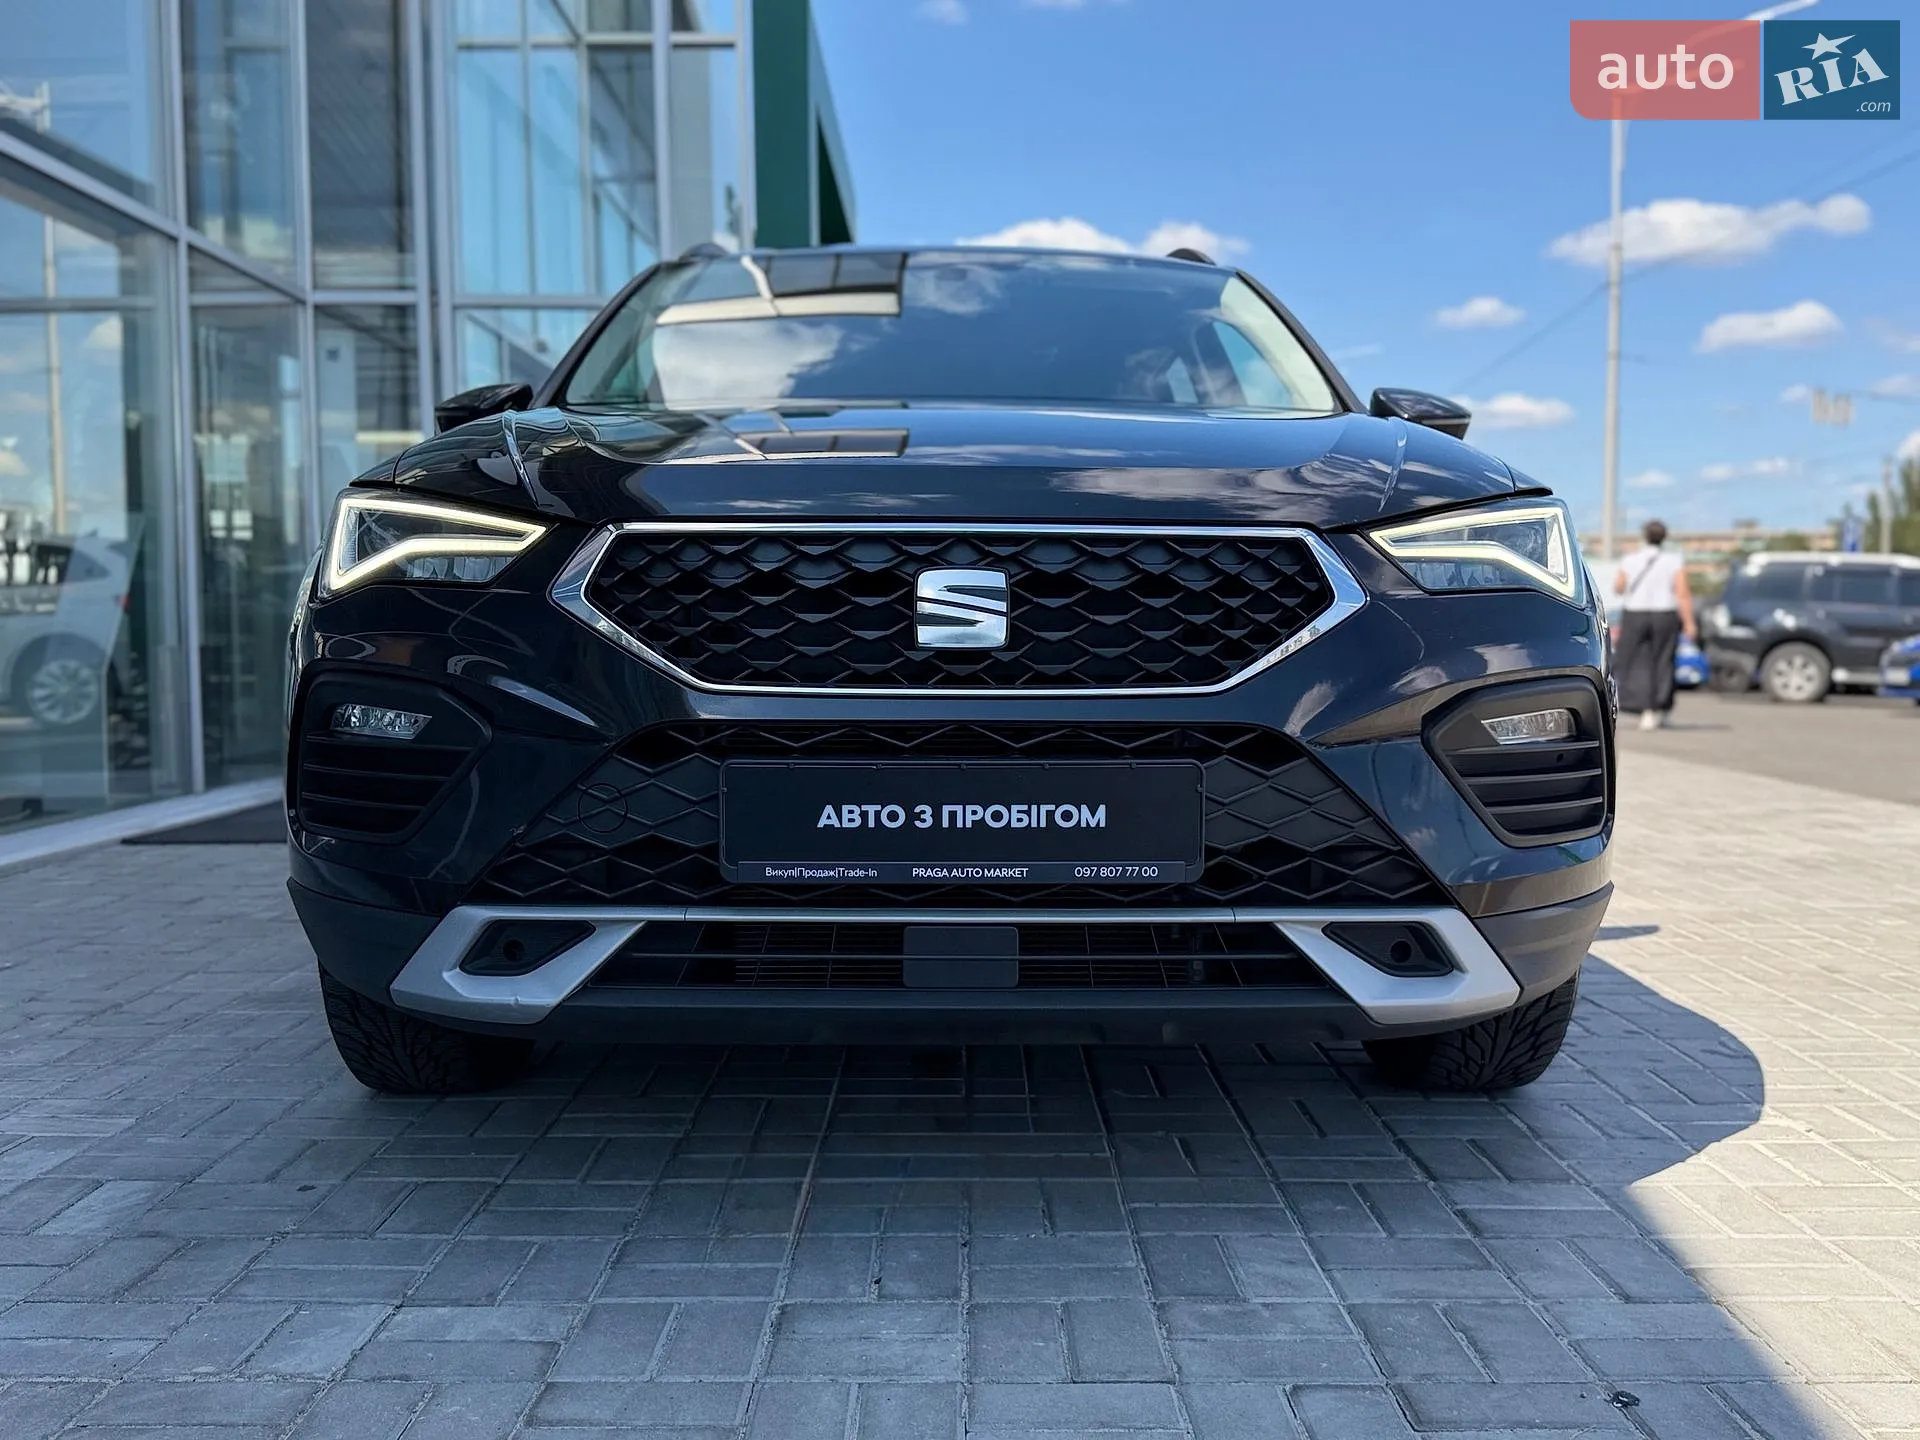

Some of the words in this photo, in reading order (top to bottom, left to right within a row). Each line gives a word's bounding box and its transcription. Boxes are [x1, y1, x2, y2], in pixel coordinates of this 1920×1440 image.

[816, 804, 906, 829] АВТО
[942, 803, 1107, 829] ПРОБІГОМ
[912, 867, 951, 879] PRAGA
[951, 867, 983, 879] AUTO
[984, 867, 1029, 879] MARKET
[1074, 866, 1098, 878] 097
[1099, 866, 1123, 878] 807
[1124, 866, 1140, 878] 77
[1141, 866, 1159, 878] 00
